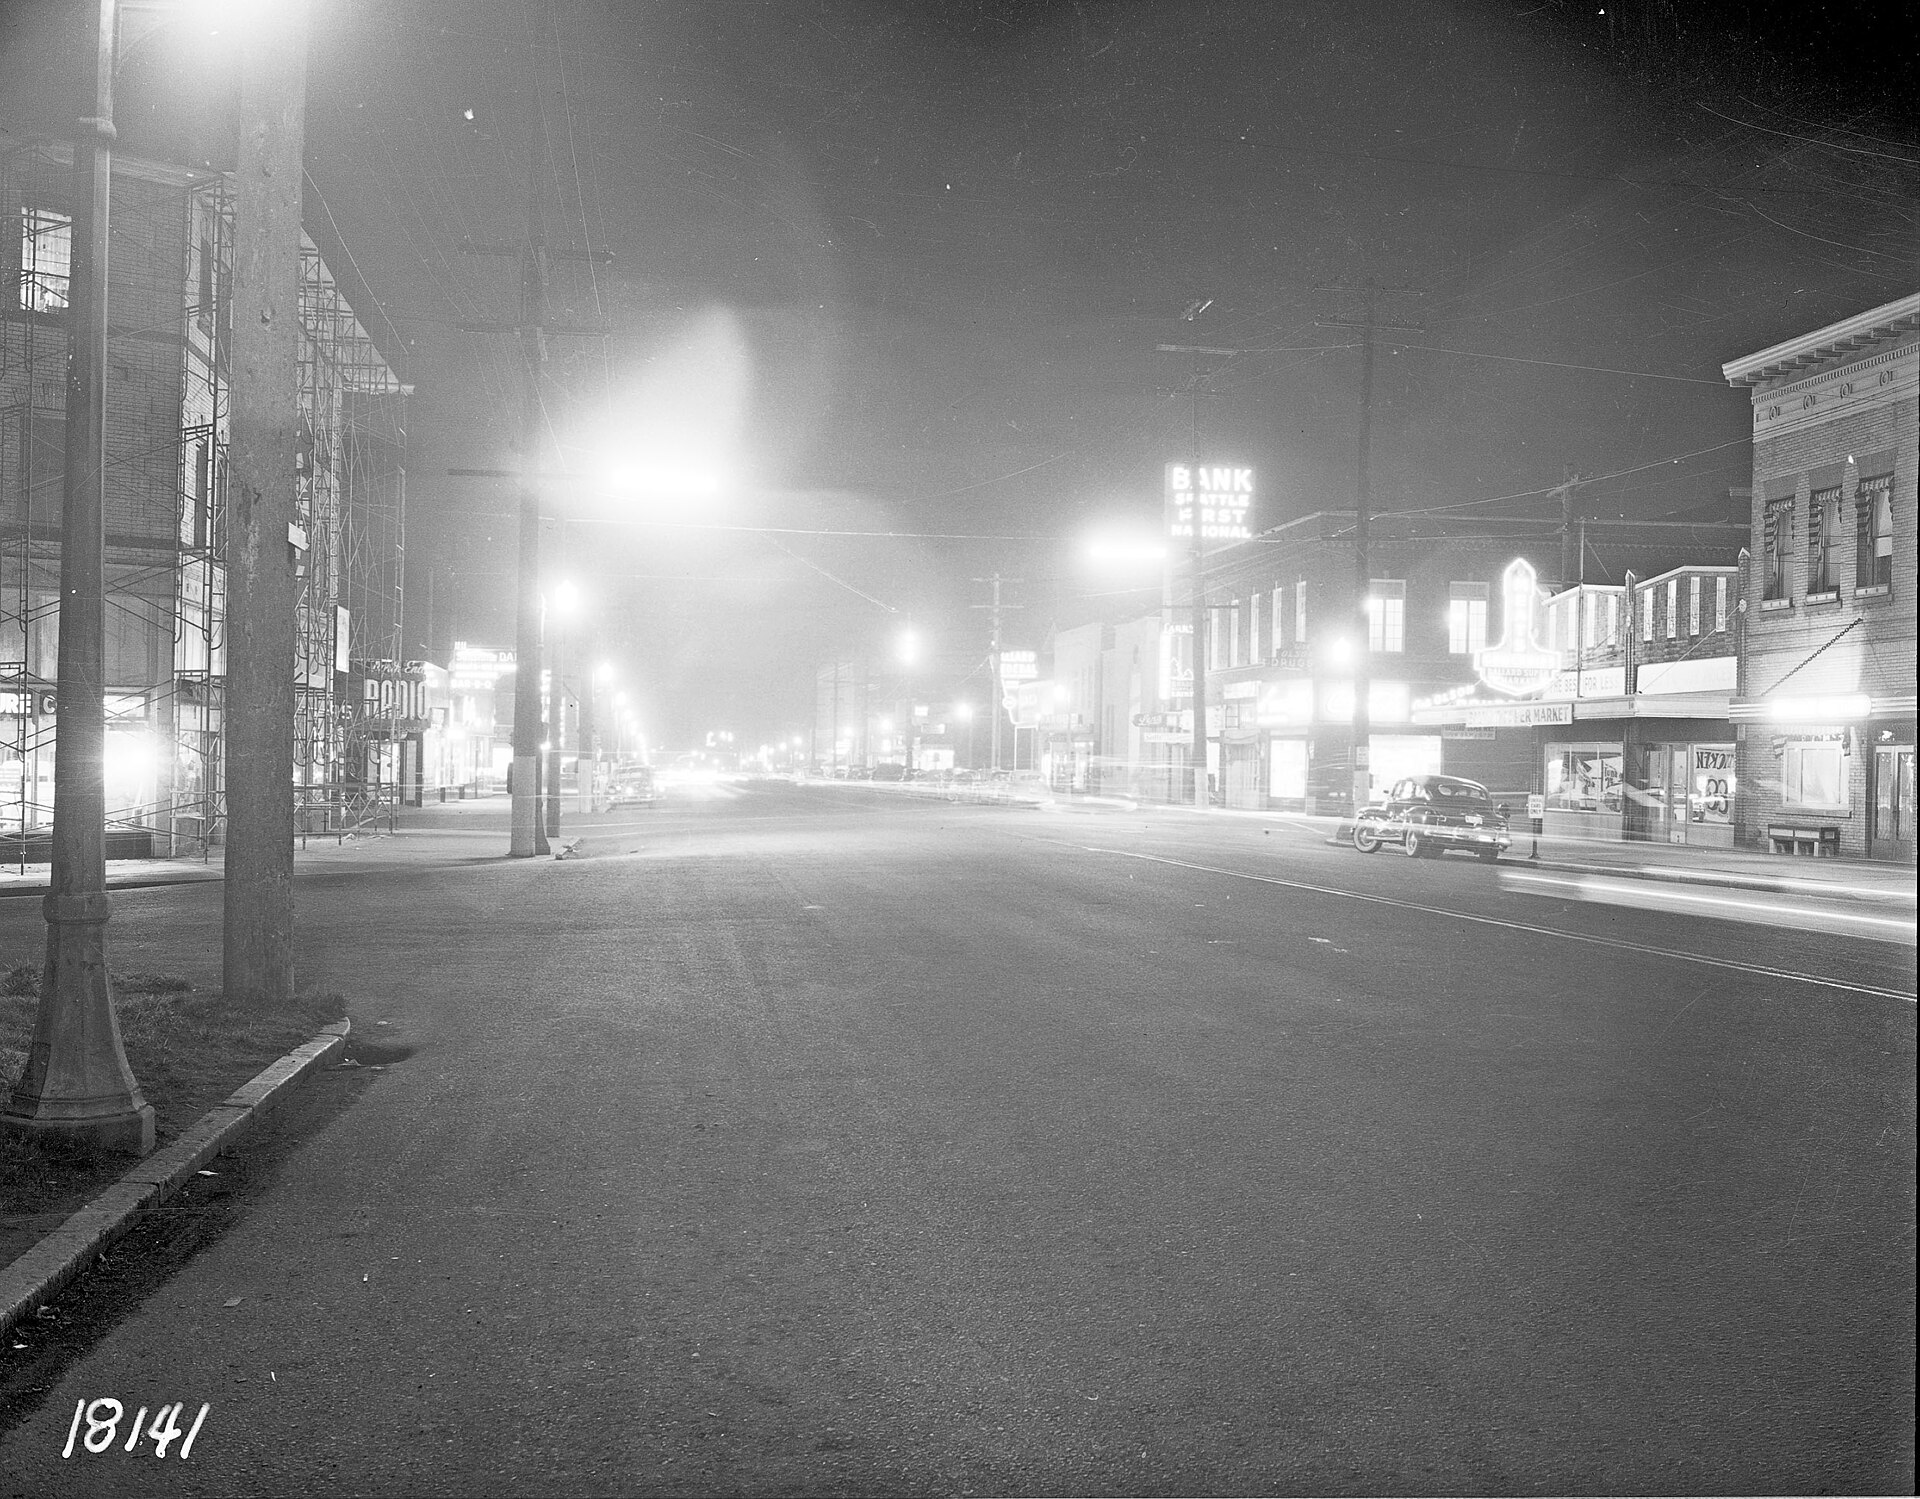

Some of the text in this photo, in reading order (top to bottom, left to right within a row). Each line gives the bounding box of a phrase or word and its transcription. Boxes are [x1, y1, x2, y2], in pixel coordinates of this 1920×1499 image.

[1172, 467, 1252, 492] BANK
[1179, 507, 1246, 523] FRST
[1171, 524, 1251, 539] NAIONAL
[364, 679, 431, 720] RADIO
[1533, 706, 1570, 723] MARKET
